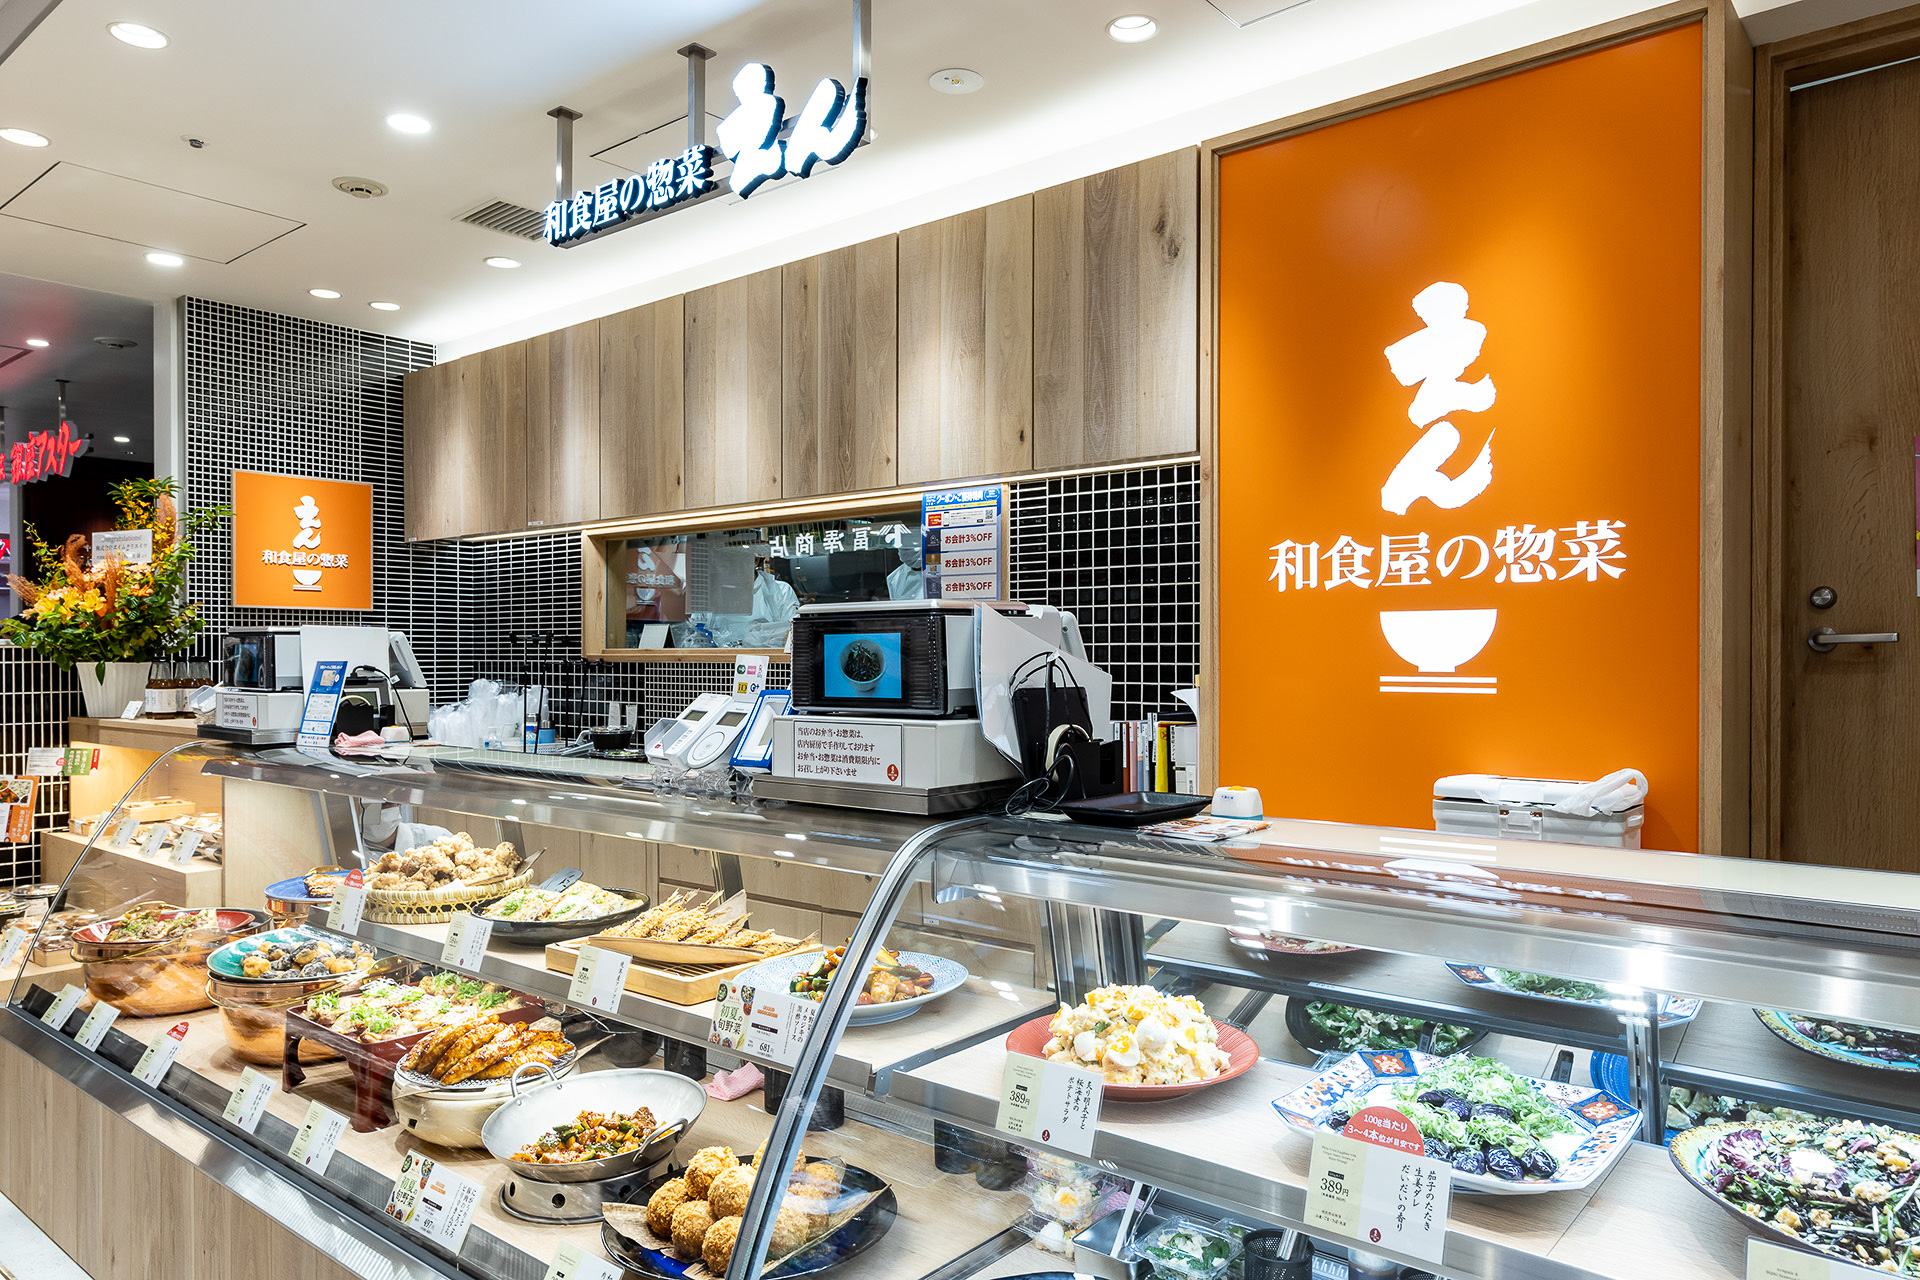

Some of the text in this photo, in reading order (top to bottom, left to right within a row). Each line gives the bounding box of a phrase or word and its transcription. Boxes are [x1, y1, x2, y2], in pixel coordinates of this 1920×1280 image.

[716, 62, 869, 200] えん
[543, 144, 710, 245] 和食屋の惣菜
[1381, 281, 1497, 516] えん
[292, 495, 322, 550] えん
[944, 532, 993, 545] お会計3%OFF
[262, 549, 349, 569] 和食屋の惣菜
[944, 556, 993, 569] お会計3%OFF
[1268, 519, 1627, 592] 和食屋の惣菜
[945, 581, 993, 593] お会計3%OFF
[720, 1003, 743, 1022] 初夏の
[718, 1018, 742, 1036] 旬野菜
[1009, 1090, 1031, 1106] 389円
[1363, 1113, 1408, 1133] 100g当たり
[1320, 1177, 1350, 1198] 389円
[1412, 1167, 1424, 1207] 生姜ダレ
[1396, 1164, 1411, 1232] だいだいの香り
[1423, 1169, 1438, 1232] 茄子のたたき
